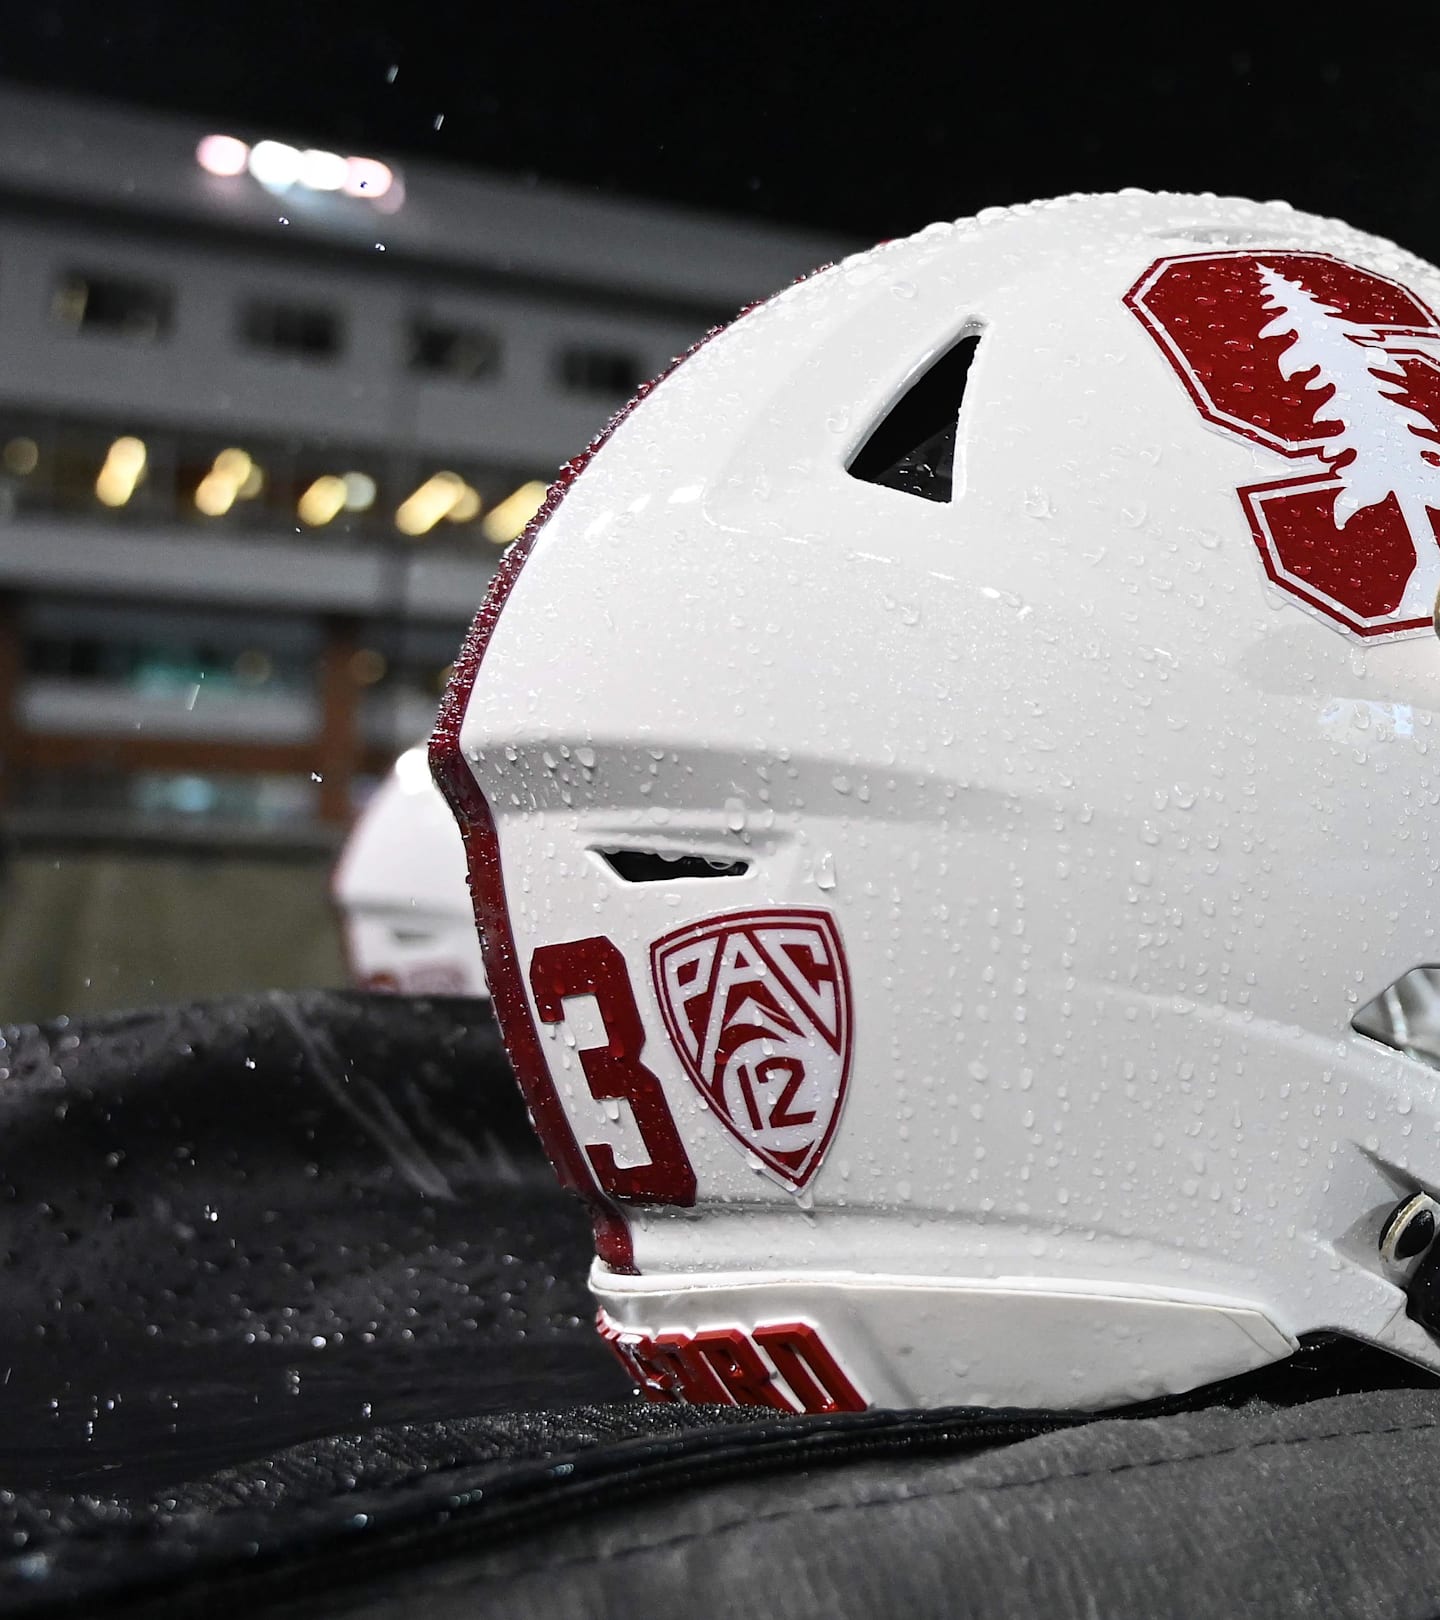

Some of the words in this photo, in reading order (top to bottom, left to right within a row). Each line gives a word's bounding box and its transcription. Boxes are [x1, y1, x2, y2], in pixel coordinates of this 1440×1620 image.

[529, 936, 697, 1207] 3
[663, 928, 839, 1072] PAC
[736, 1056, 818, 1131] 12
